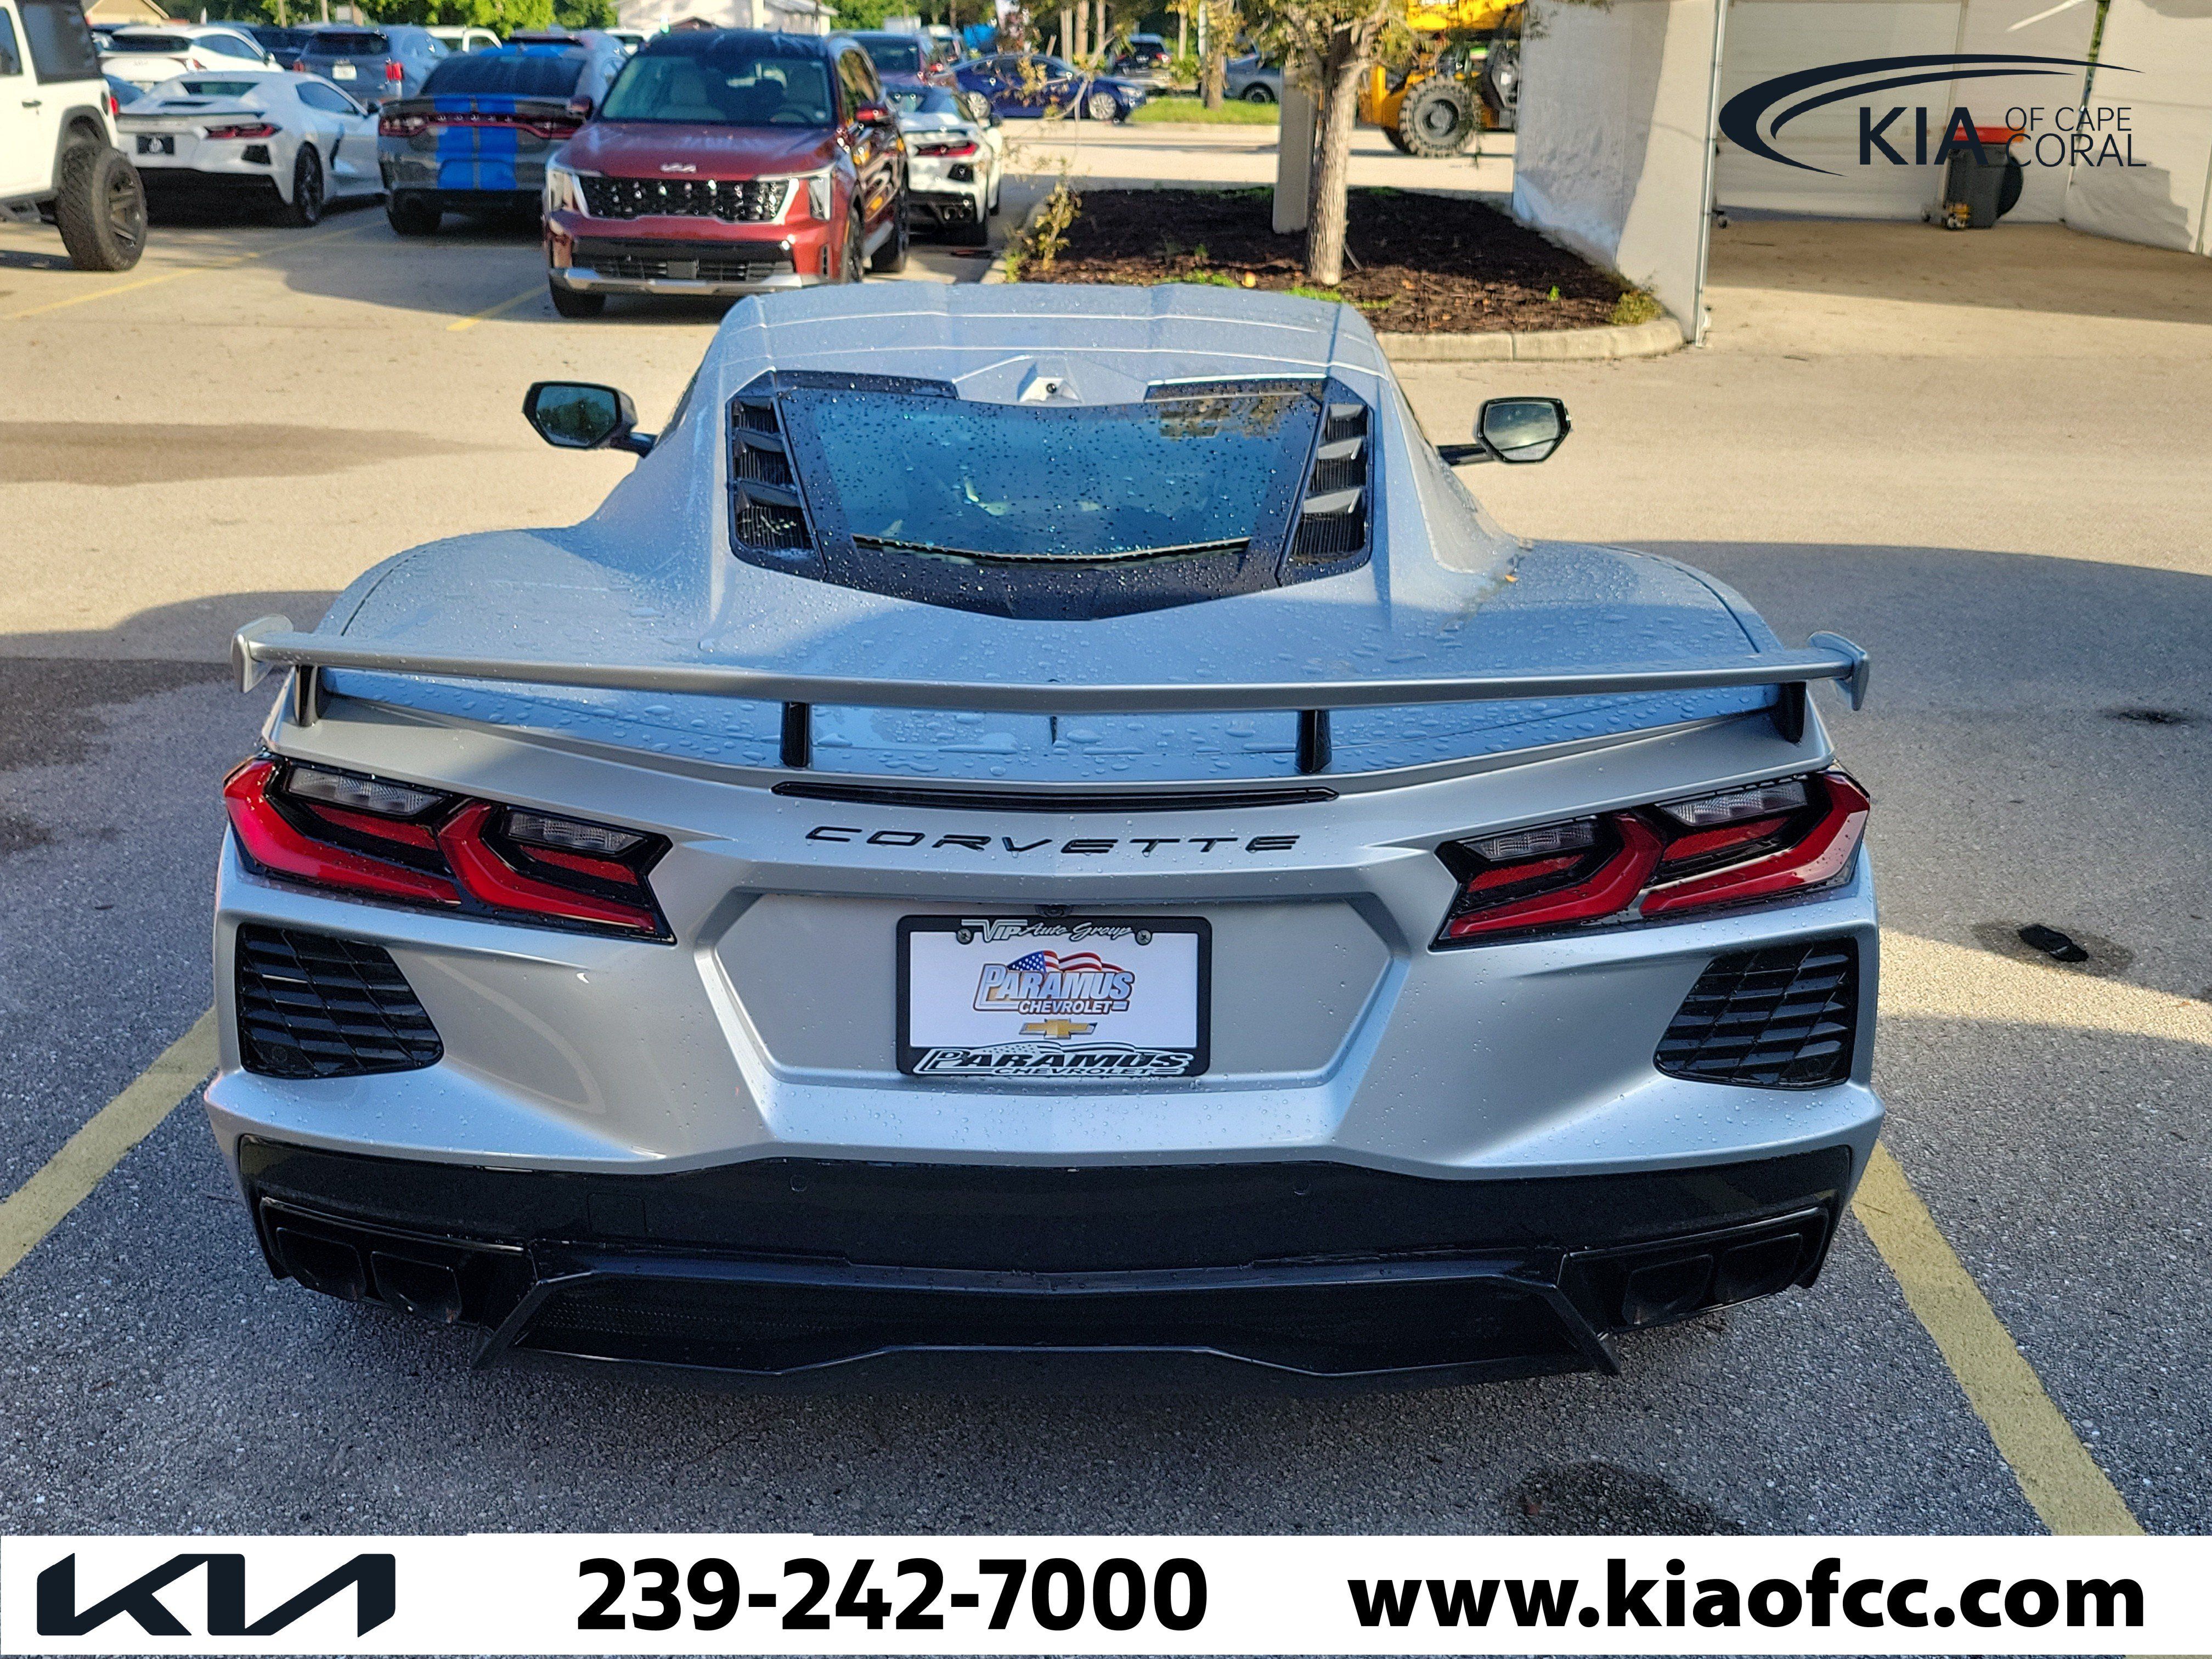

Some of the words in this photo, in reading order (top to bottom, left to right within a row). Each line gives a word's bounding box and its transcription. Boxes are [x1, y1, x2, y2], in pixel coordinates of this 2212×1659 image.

[805, 826, 1300, 854] CORVETTE
[961, 919, 1028, 942] VIP
[1019, 922, 1068, 936] Auto
[1069, 922, 1132, 941] Group
[974, 963, 1135, 1011] PARAMUS
[1018, 1000, 1113, 1015] CHEVROLET
[924, 1049, 1194, 1071] PARAMUS
[994, 1067, 1153, 1076] CHEVROLET
